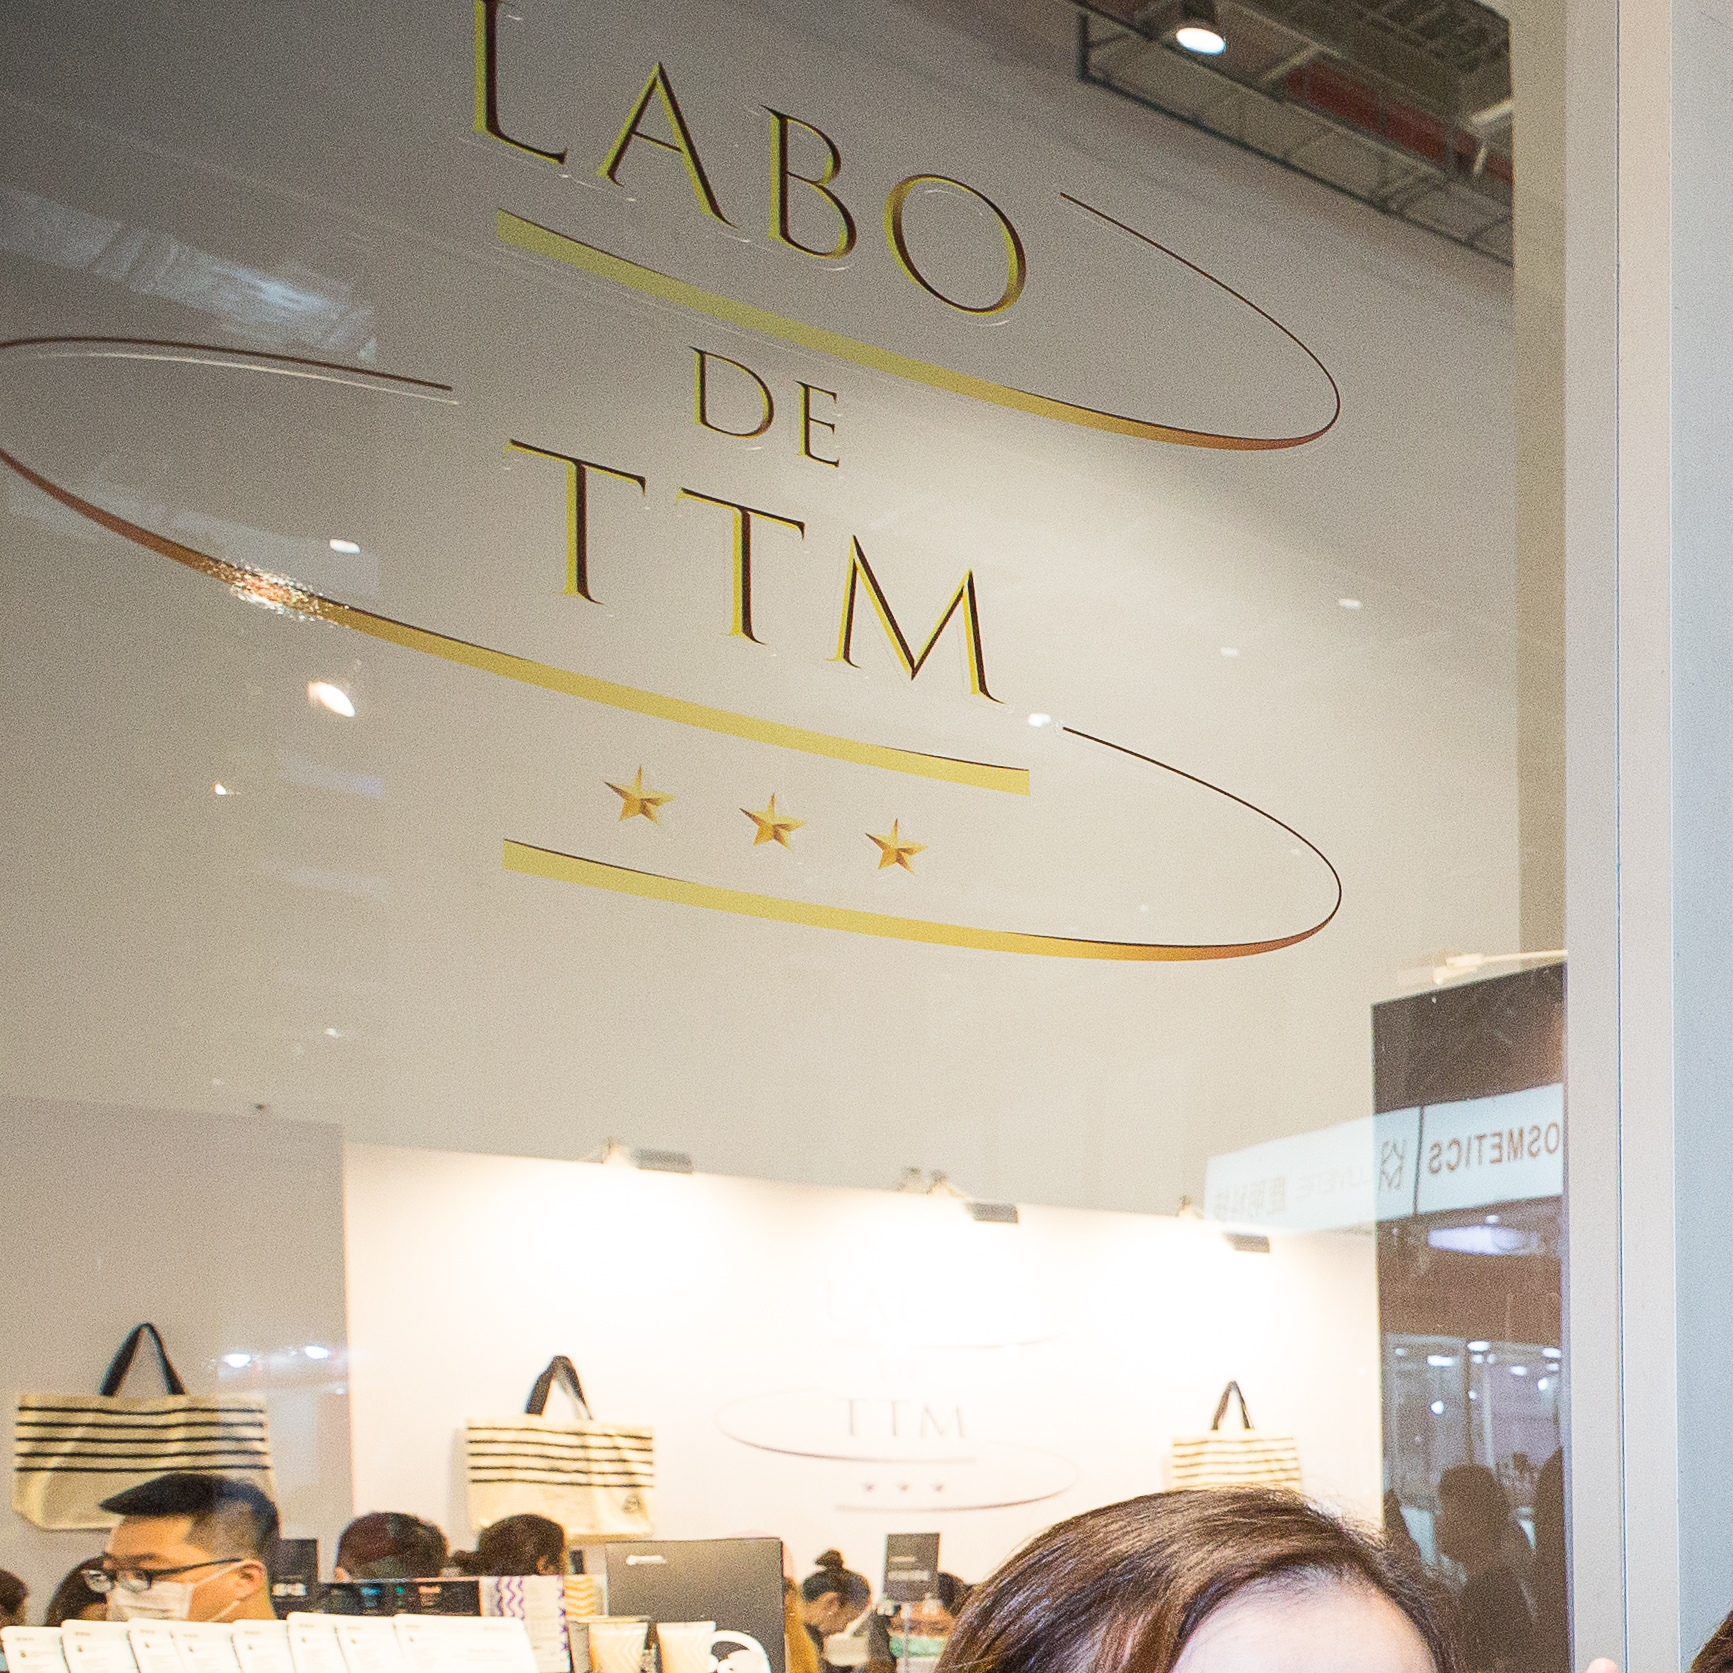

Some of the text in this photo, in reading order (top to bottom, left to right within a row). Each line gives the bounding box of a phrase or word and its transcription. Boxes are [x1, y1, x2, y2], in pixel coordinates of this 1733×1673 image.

[473, 0, 1028, 316] LABO
[691, 346, 843, 468] DE
[506, 439, 1006, 705] TTM
[834, 1396, 968, 1440] TTM
